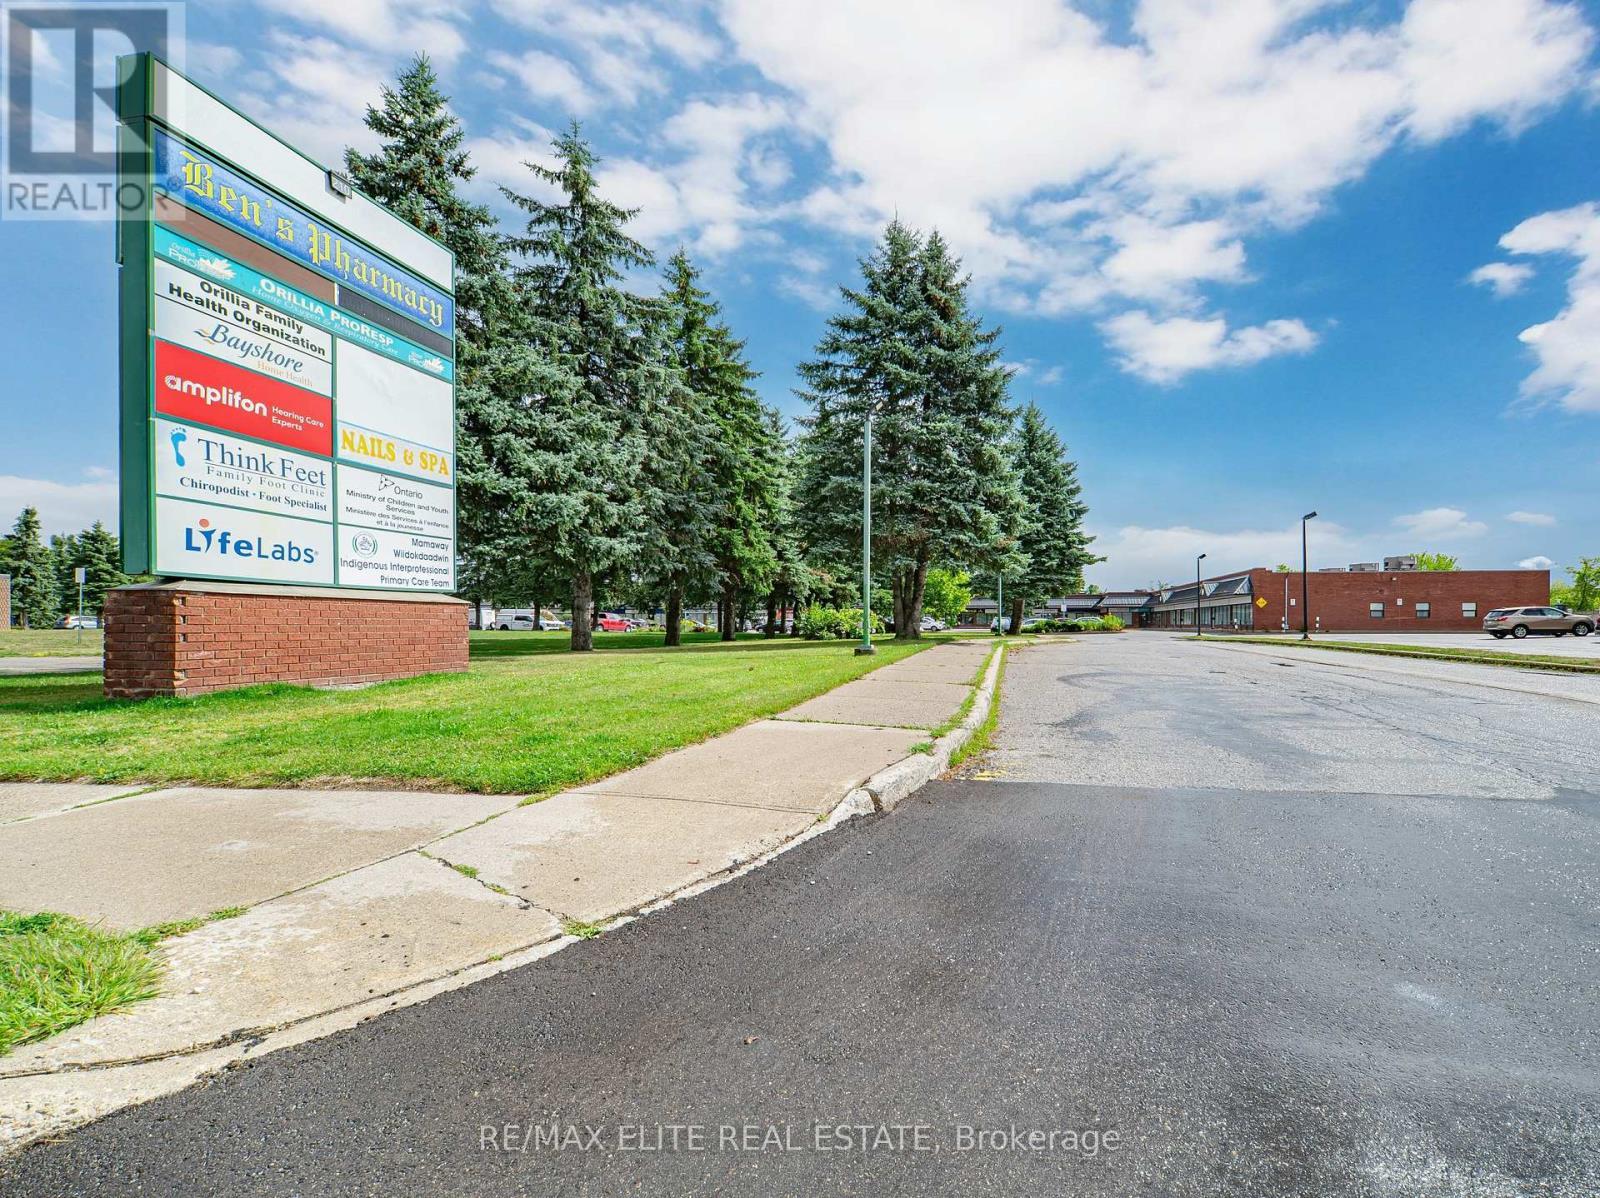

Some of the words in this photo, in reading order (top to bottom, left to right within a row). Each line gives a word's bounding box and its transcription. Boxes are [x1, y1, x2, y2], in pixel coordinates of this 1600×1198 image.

[179, 149, 295, 242] Ben's
[308, 222, 445, 328] Pharmacy
[200, 281, 250, 310] Orillia
[256, 304, 304, 335] Family
[260, 278, 325, 316] ORILLIA
[168, 282, 227, 317] Health
[233, 310, 326, 356] Organization
[209, 323, 304, 373] Bayshore
[257, 360, 285, 378] Home
[286, 369, 313, 387] Health
[164, 374, 268, 417] amplifon
[272, 406, 305, 423] Hearing
[306, 416, 324, 428] Care
[272, 417, 303, 432] Experts
[198, 438, 275, 475] Think
[280, 457, 327, 486] Feet
[341, 428, 396, 463] NAILS
[403, 449, 414, 466] &
[419, 451, 450, 477] SPA
[179, 476, 250, 498] Chiropodist
[259, 491, 281, 503] Foot
[284, 495, 327, 512] Specialist
[206, 465, 253, 485] Family
[259, 476, 287, 490] Foot
[291, 483, 326, 498] Clinic
[394, 486, 423, 499] Ontario
[346, 489, 376, 502] Ministry
[387, 497, 416, 509] Children
[431, 505, 449, 515] Youth
[385, 505, 416, 516] Services
[391, 515, 418, 524] Services
[411, 538, 449, 551] Mamaway
[340, 558, 388, 571] Indigenous
[390, 562, 449, 575] Interprofessional
[380, 575, 409, 586] Primary
[411, 577, 429, 587] Care
[431, 578, 450, 587] Team
